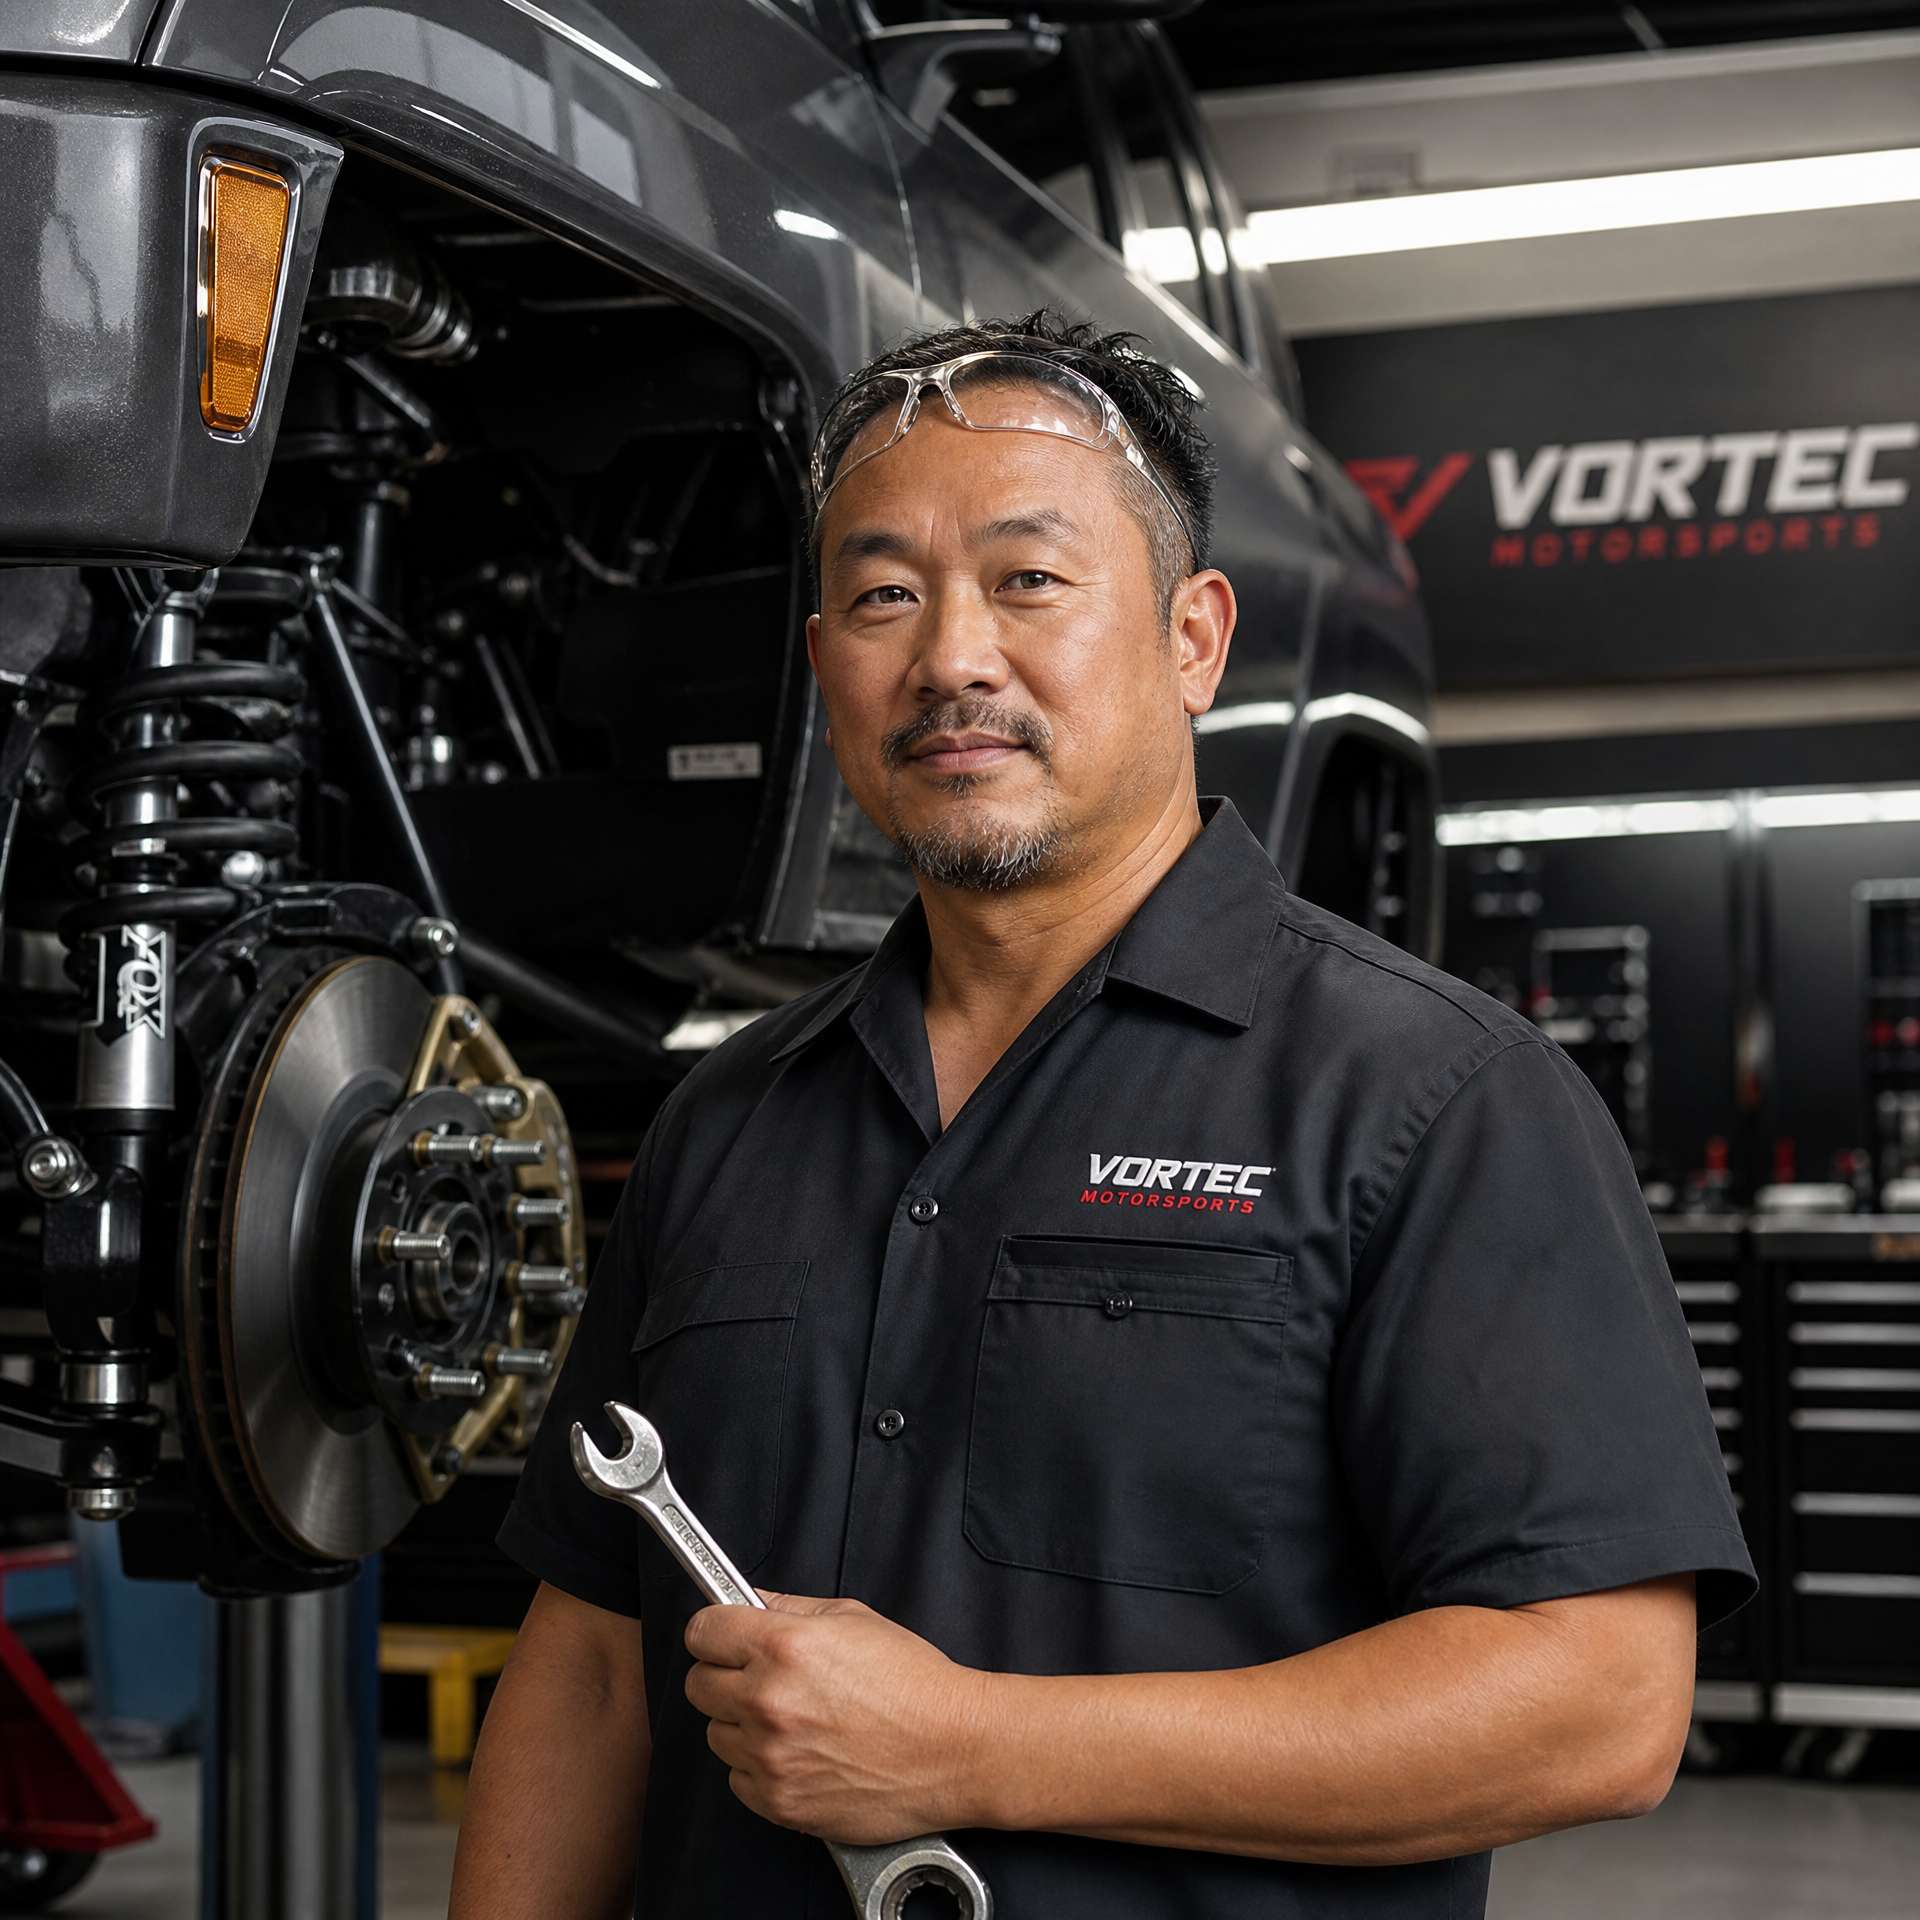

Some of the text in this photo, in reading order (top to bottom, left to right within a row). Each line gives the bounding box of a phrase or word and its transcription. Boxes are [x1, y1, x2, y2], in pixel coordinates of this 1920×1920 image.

[1488, 425, 1919, 528] VORTEC
[1492, 516, 1879, 565] MOTORSPORTS
[117, 925, 167, 1039] FOX
[1089, 1153, 1272, 1197] VORTEC
[1080, 1189, 1255, 1214] MOTORSPORTS
